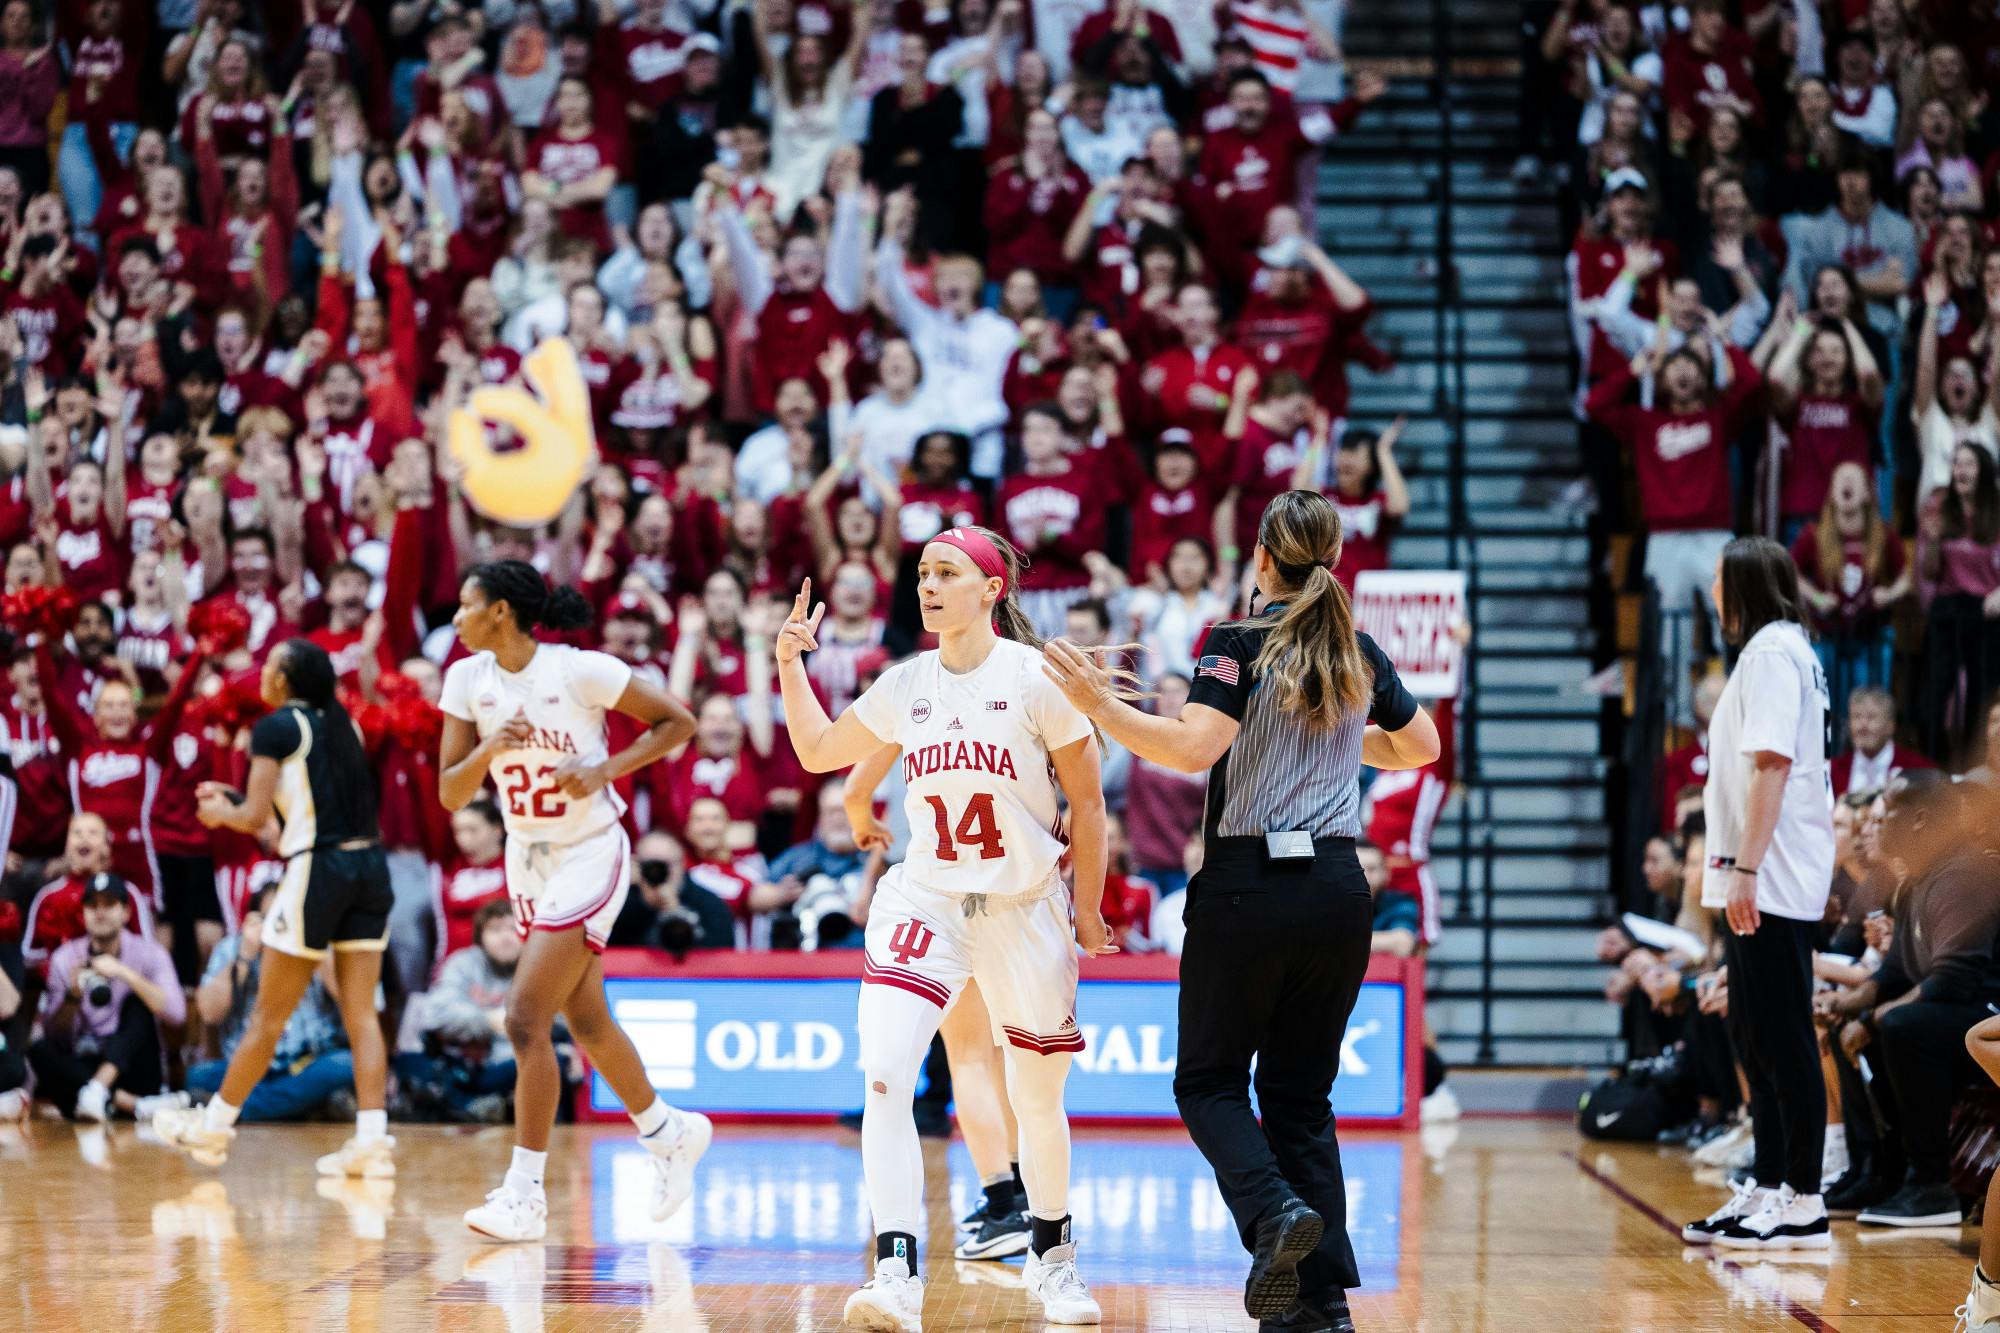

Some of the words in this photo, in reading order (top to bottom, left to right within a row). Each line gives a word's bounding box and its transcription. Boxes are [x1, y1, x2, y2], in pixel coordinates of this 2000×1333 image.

[904, 740, 1018, 785] INDIANA
[503, 764, 567, 818] 22
[924, 793, 1006, 862] 14
[705, 1020, 844, 1072] OLD
